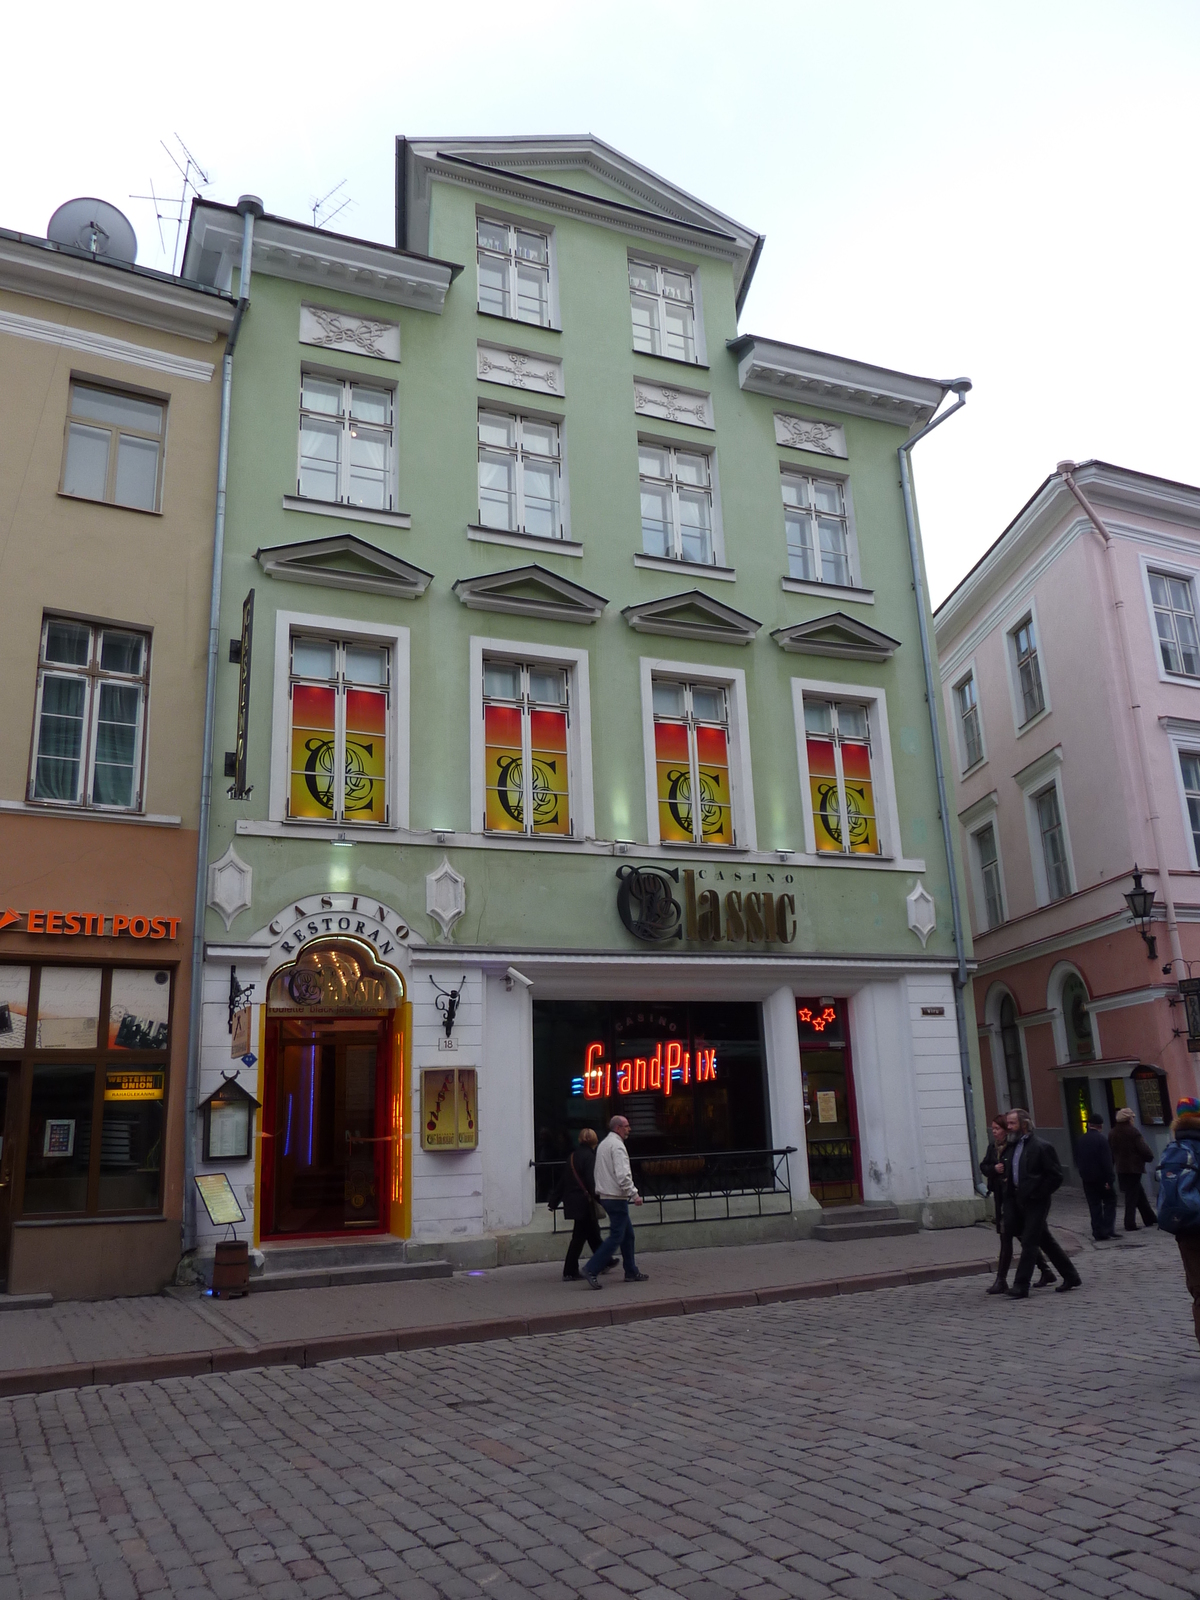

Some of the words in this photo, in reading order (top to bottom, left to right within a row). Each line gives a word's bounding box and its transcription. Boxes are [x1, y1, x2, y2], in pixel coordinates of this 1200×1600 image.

[697, 868, 794, 885] CASINO
[616, 864, 797, 944] Classic
[27, 909, 105, 937] EESTI
[112, 913, 182, 940] POST
[269, 895, 410, 941] CASINO
[280, 916, 395, 956] RESTORAN
[615, 1012, 677, 1032] CASINO
[444, 1040, 453, 1049] 18
[107, 1075, 153, 1083] WESTERN
